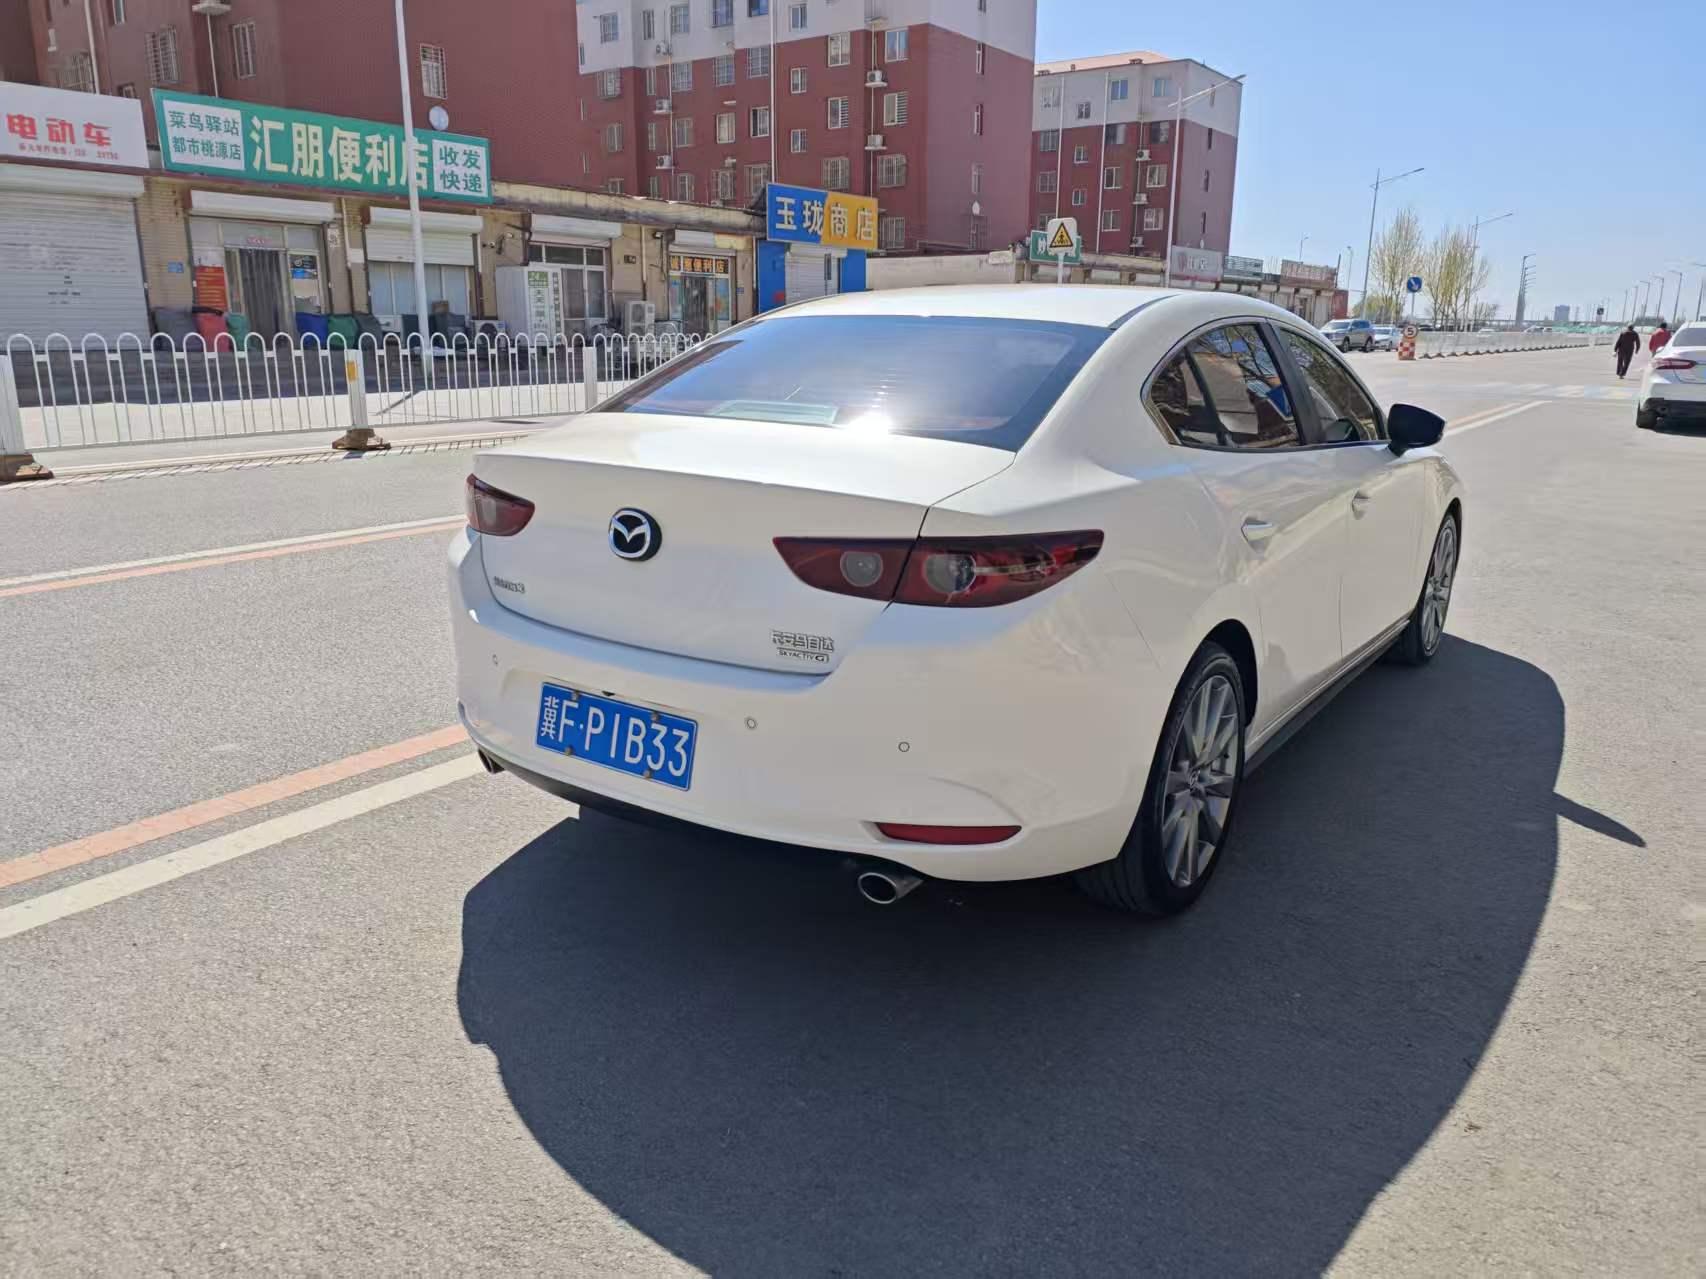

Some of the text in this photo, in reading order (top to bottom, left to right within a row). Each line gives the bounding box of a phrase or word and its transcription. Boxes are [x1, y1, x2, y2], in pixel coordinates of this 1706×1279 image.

[6, 112, 112, 147] 电动车
[168, 110, 240, 137] 菜鸟驿站
[172, 136, 242, 161] 都市桃源店
[249, 115, 429, 191] 汇朋便利店
[439, 145, 481, 170] 收发
[440, 169, 484, 194] 快递
[774, 195, 874, 241] 玉珑商店
